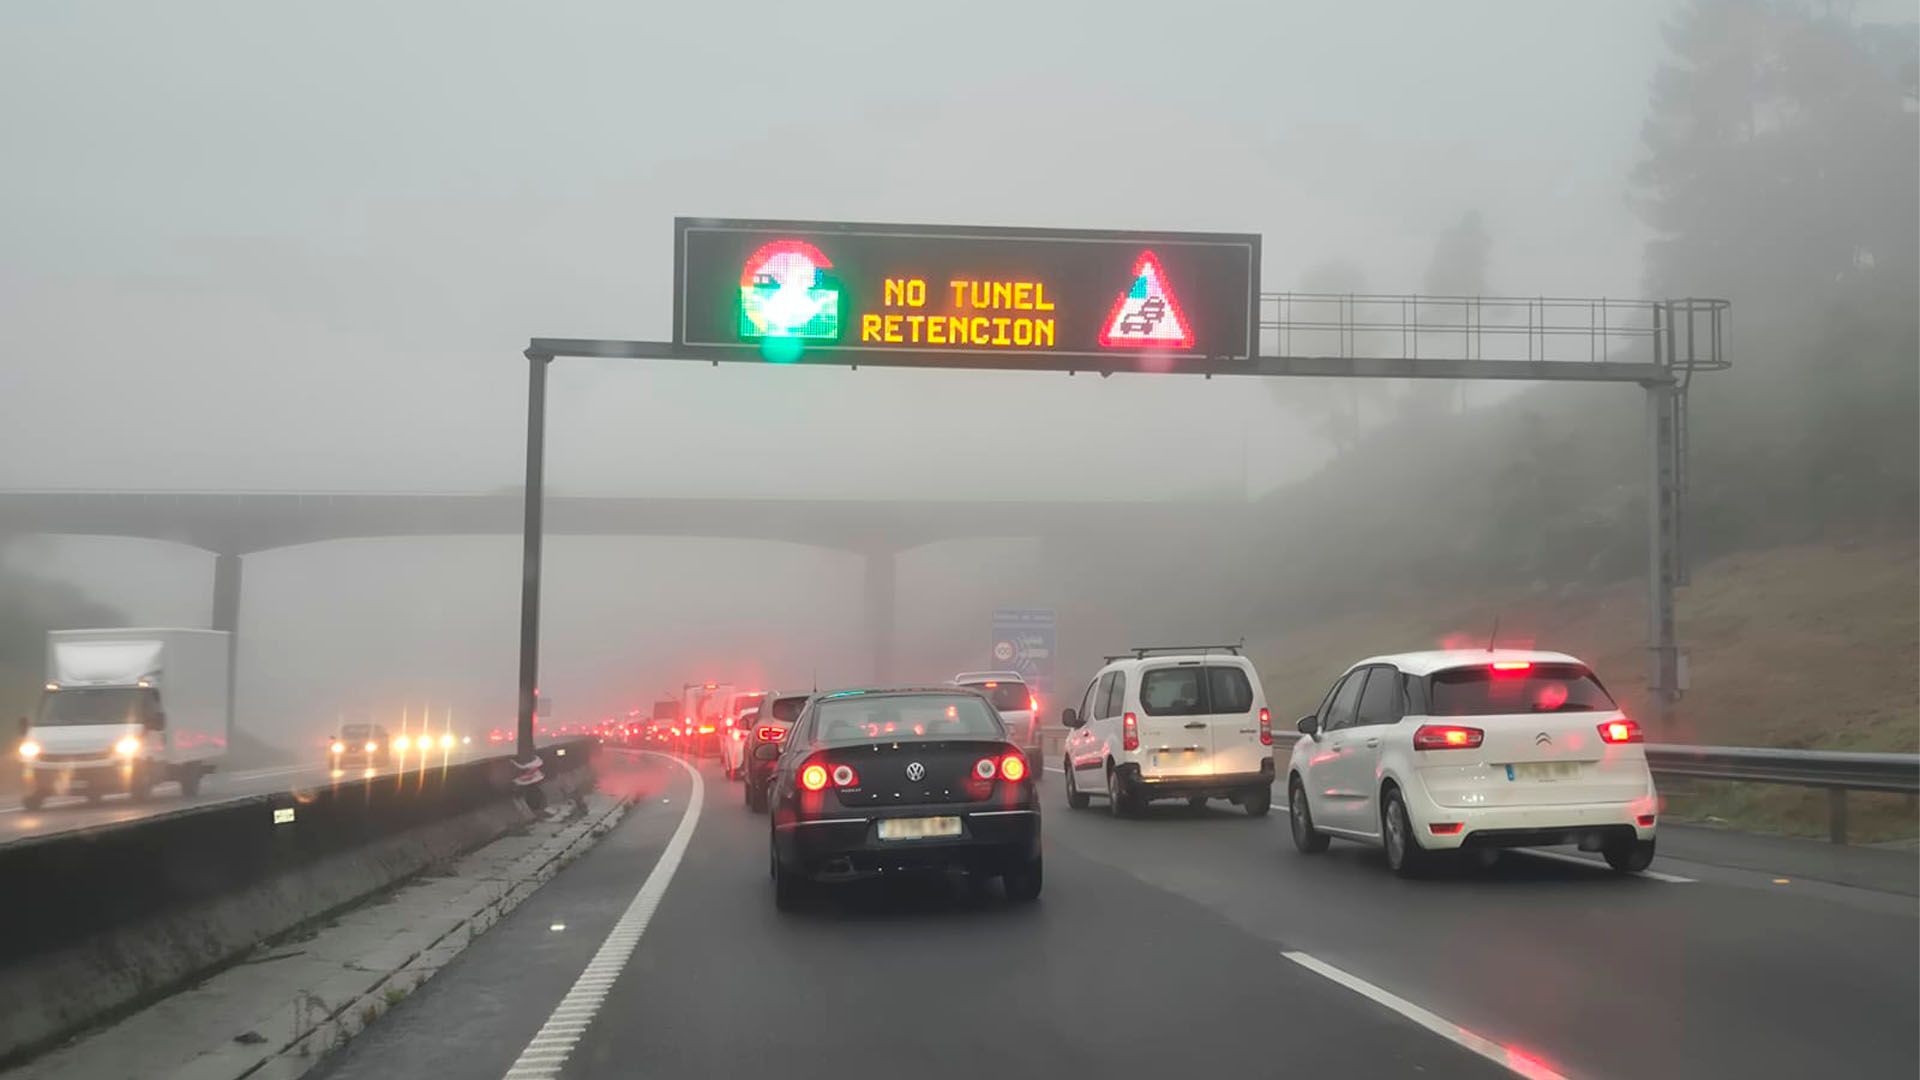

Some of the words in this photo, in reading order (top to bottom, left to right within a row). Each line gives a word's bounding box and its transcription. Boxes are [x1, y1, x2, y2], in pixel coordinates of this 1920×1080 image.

[885, 278, 926, 306] NO
[950, 281, 1055, 310] TUNEL
[862, 314, 1055, 346] RETENCION
